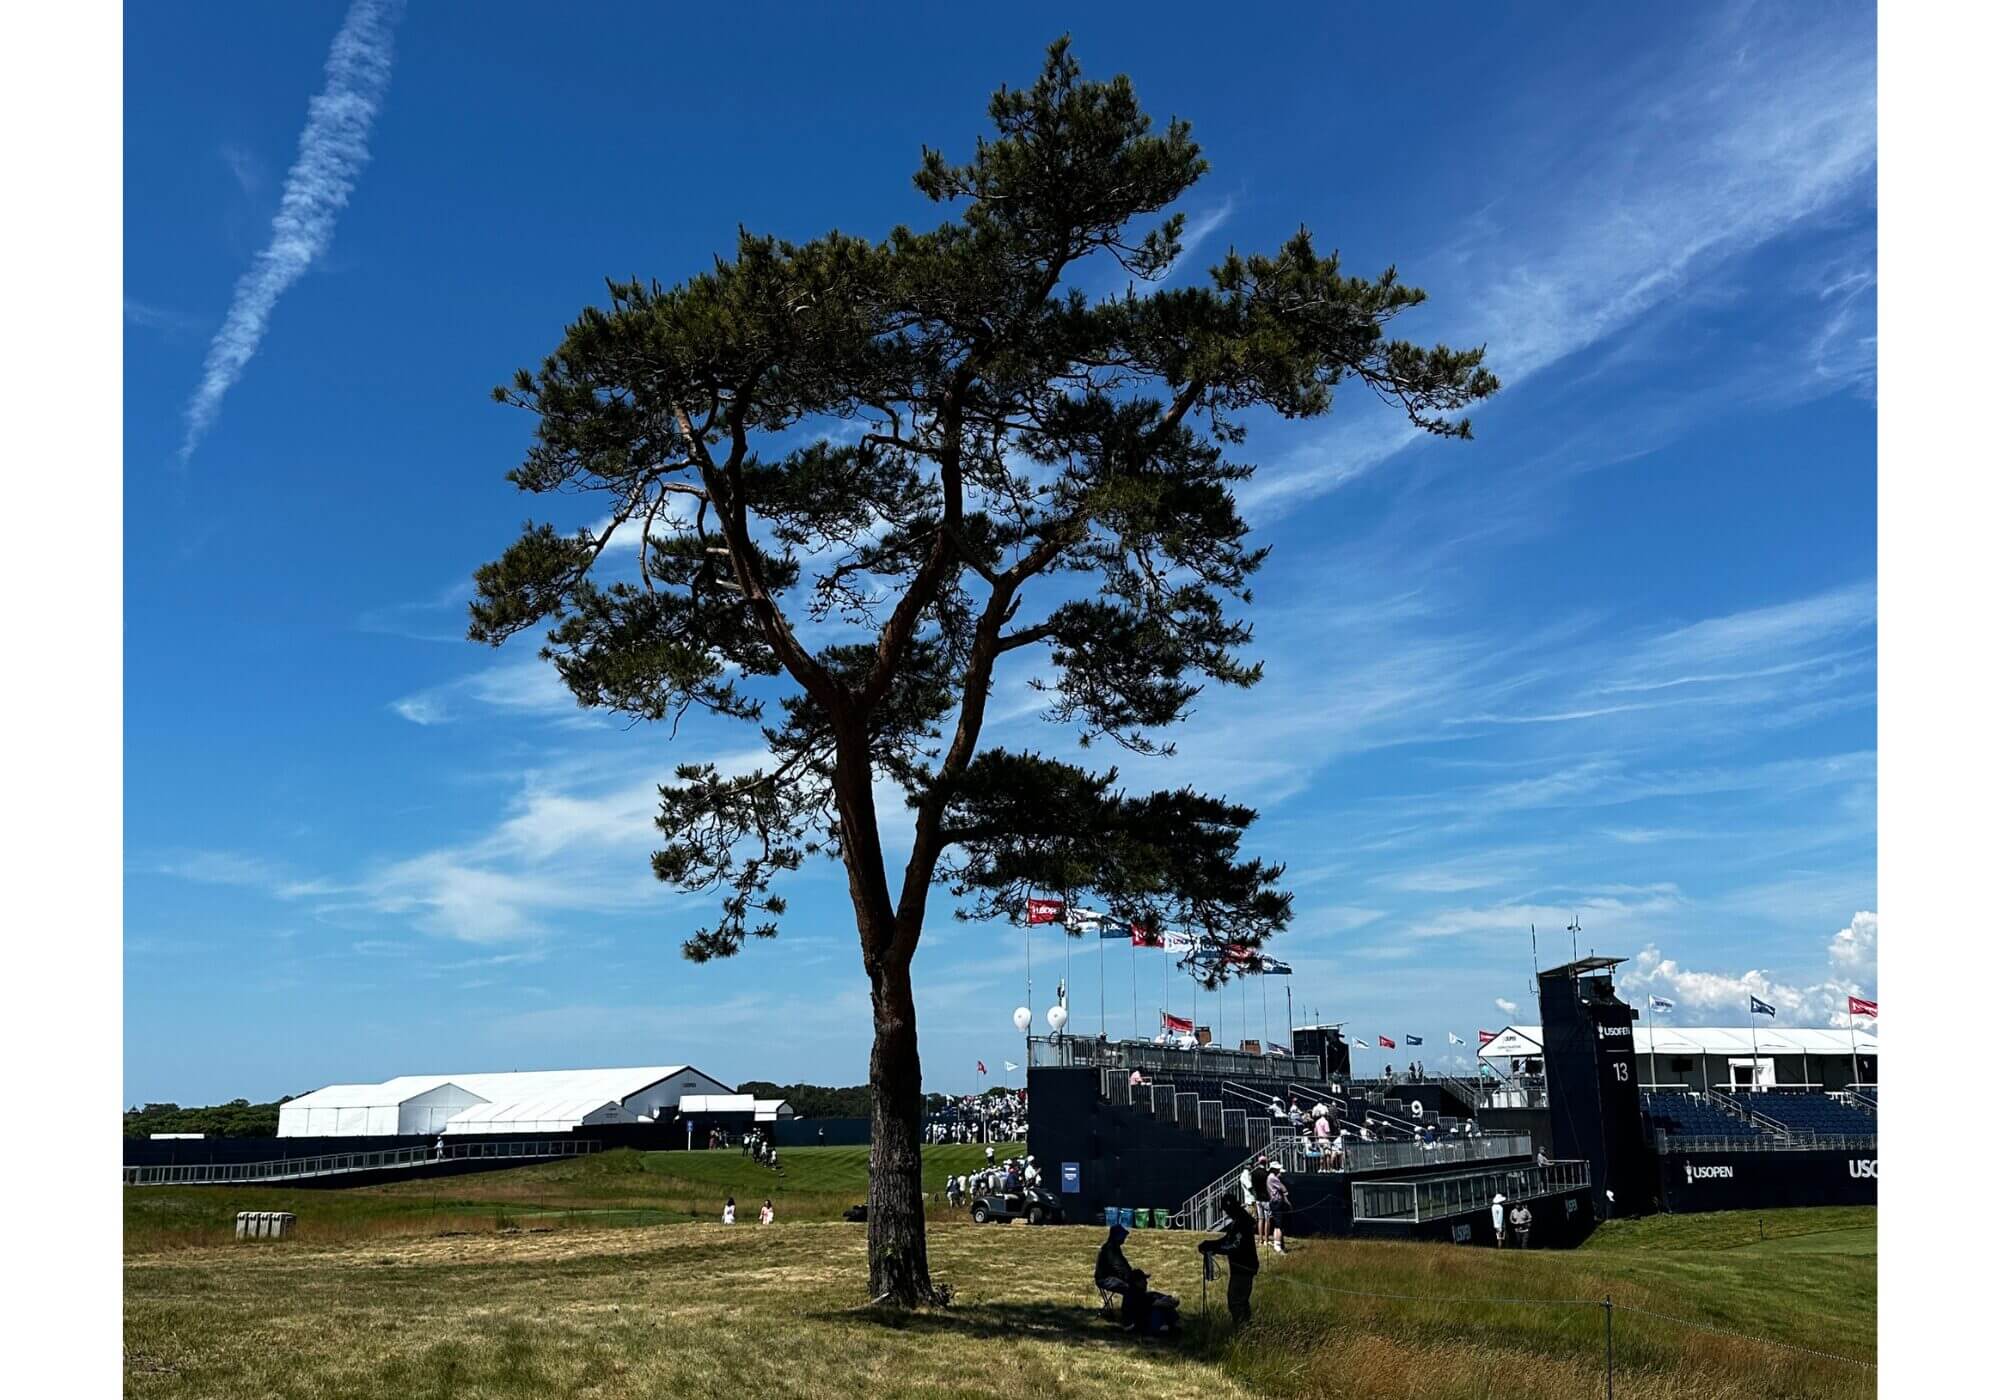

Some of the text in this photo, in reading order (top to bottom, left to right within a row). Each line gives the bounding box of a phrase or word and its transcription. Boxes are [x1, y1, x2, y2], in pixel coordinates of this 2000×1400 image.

[1613, 1062, 1629, 1081] 13
[1411, 1100, 1423, 1118] 9
[1693, 1166, 1733, 1178] USOPEN
